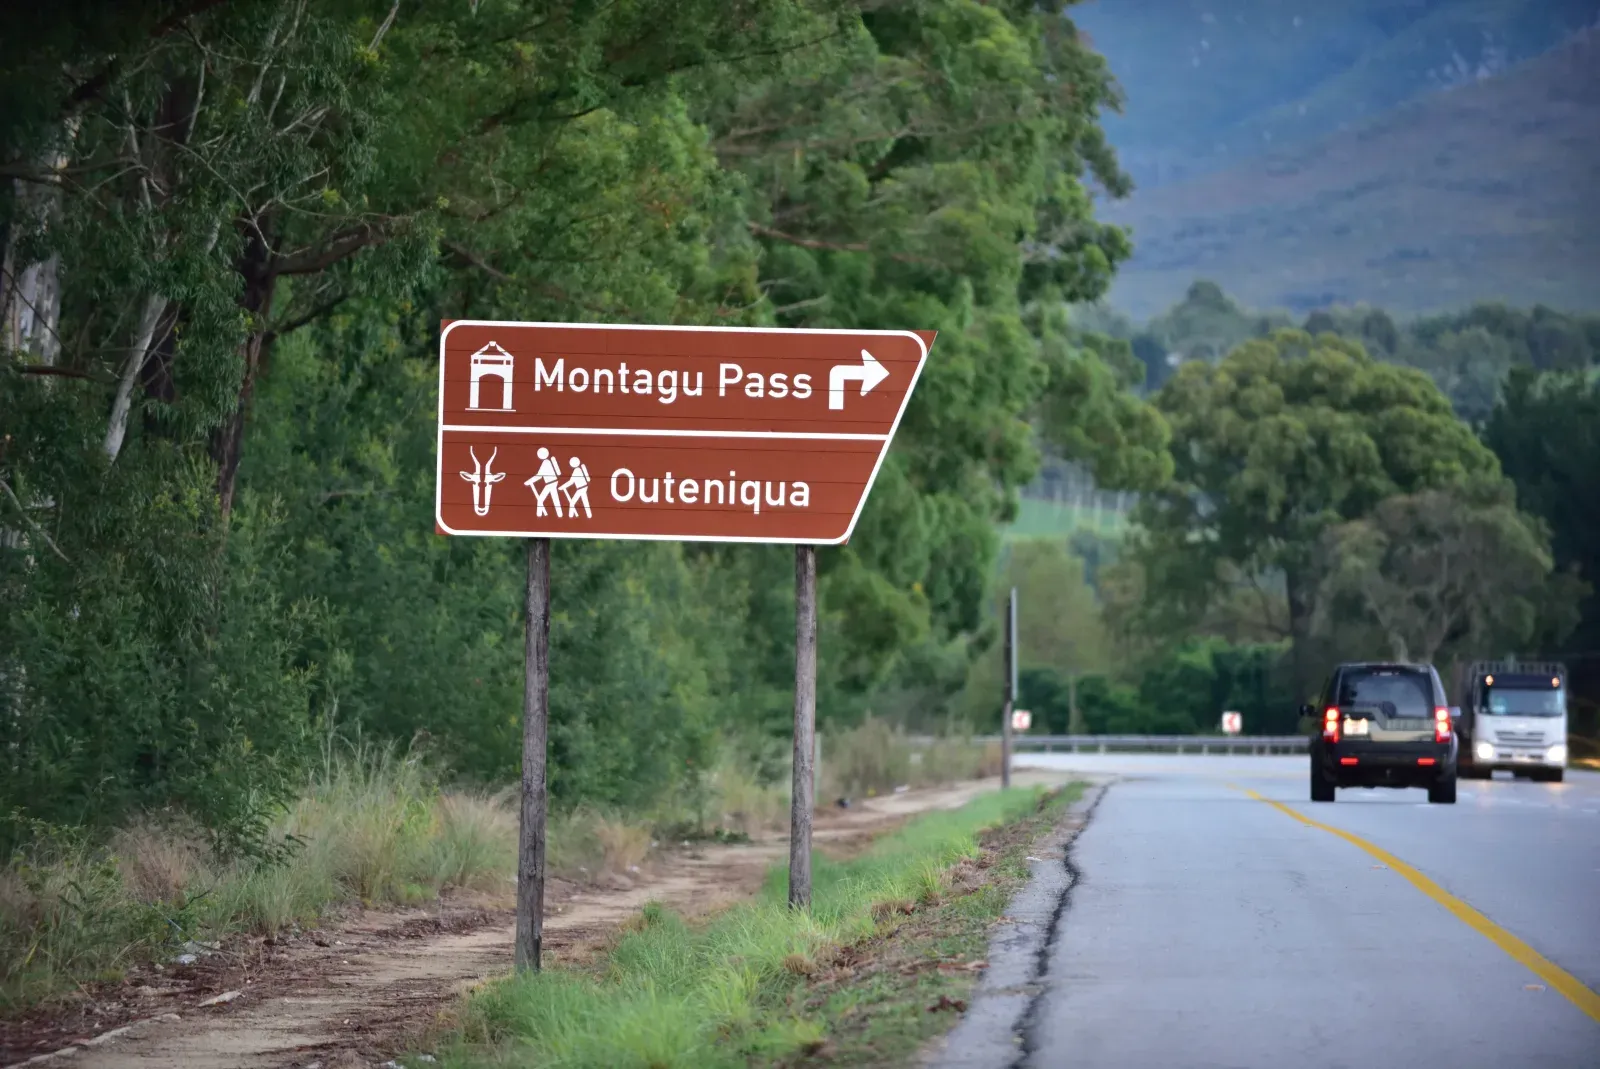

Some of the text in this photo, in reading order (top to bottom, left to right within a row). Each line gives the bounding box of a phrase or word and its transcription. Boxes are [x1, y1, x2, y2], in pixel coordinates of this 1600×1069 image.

[535, 358, 812, 404] Montagu Pass
[611, 468, 809, 514] Outeniqua
